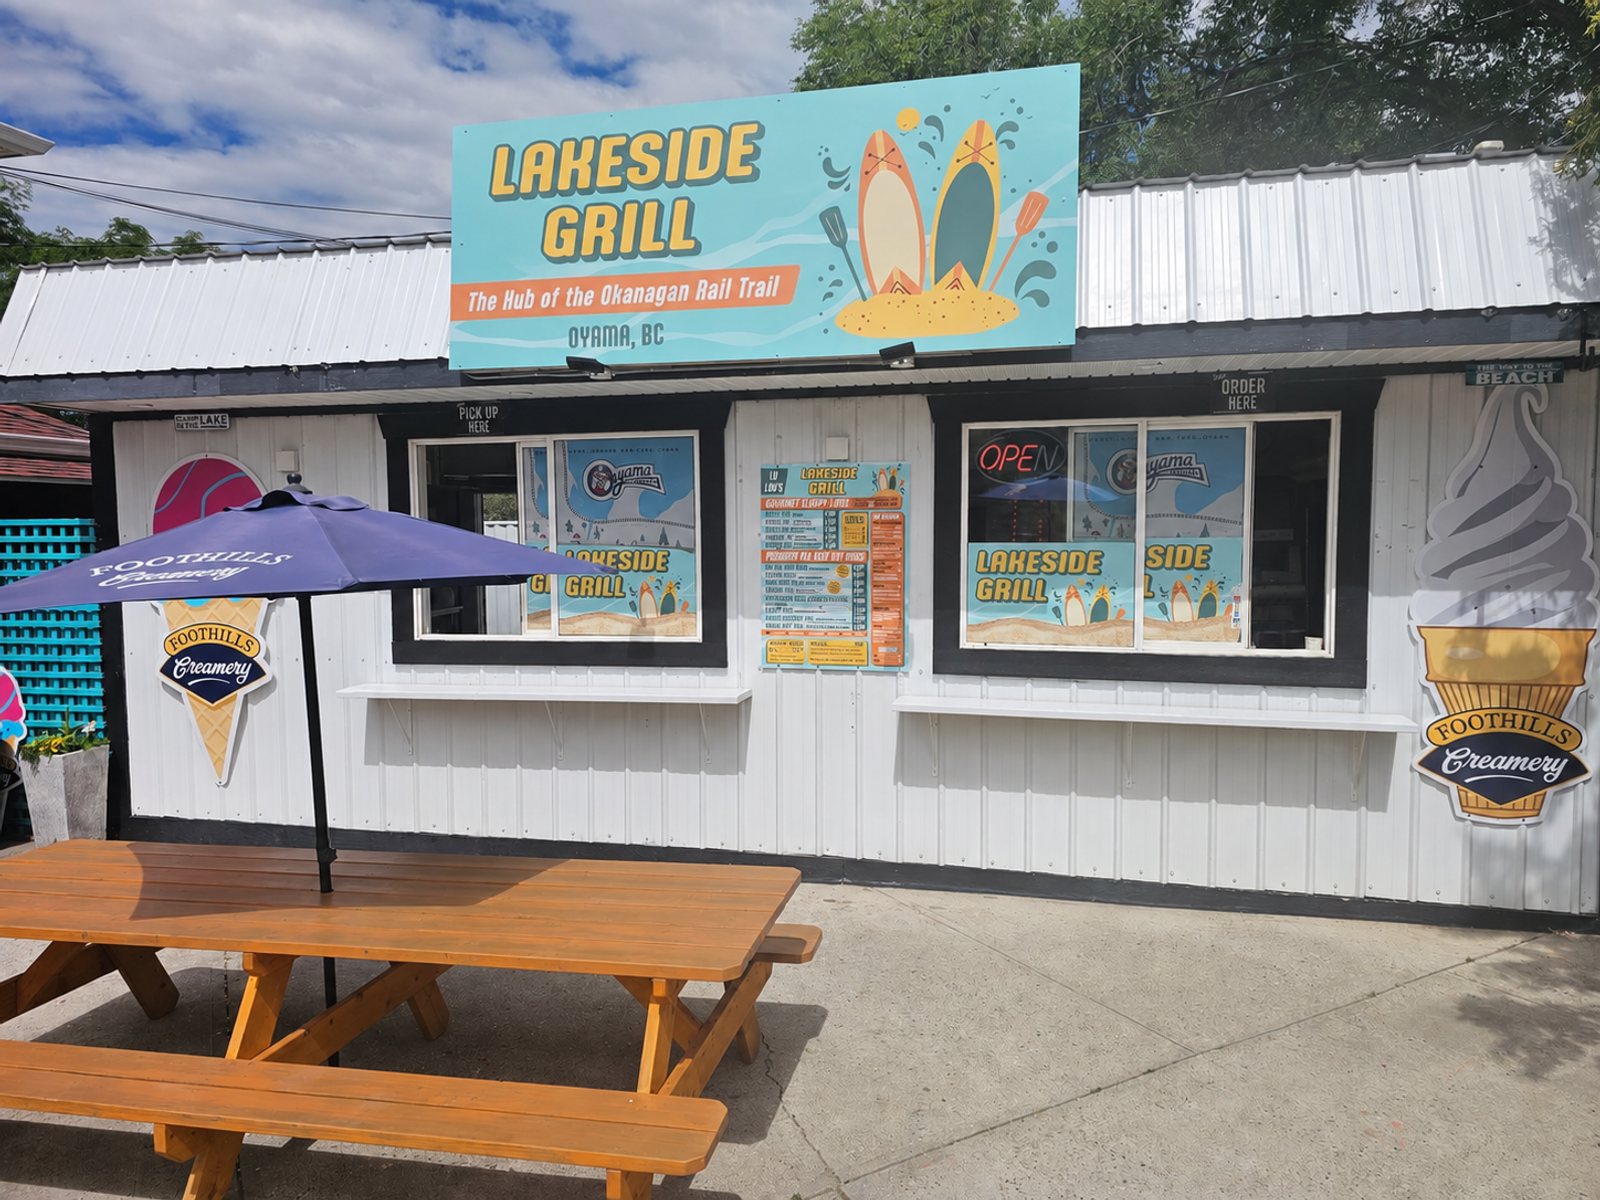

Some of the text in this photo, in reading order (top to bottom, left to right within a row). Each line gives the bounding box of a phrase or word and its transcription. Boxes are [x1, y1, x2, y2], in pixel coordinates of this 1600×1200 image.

[489, 121, 765, 201] LAKESIDE
[541, 196, 701, 264] GRILL
[468, 274, 781, 312] The Hub of the Okanagan Rail Trail
[568, 323, 664, 349] OYAMA, BC
[1222, 378, 1266, 394] ORDER
[1476, 371, 1554, 385] BEACH
[459, 405, 499, 420] PICK UP
[1228, 395, 1257, 410] HERE
[200, 414, 228, 425] LAKE
[468, 420, 490, 433] HERE
[979, 443, 1060, 472] OPEN
[800, 467, 858, 480] LAKESIDE
[808, 481, 847, 495] GRILL
[90, 551, 294, 577] FOOTHILLS
[976, 550, 1104, 575] LAKESIDE
[98, 565, 250, 588] Creamery
[565, 575, 626, 599] GRILL
[976, 578, 1049, 603] GRILL
[168, 626, 254, 653] FOOTHILLS
[173, 656, 252, 685] Creamery
[1435, 712, 1572, 745] FOOTHILLS
[1441, 747, 1568, 783] Creamery
